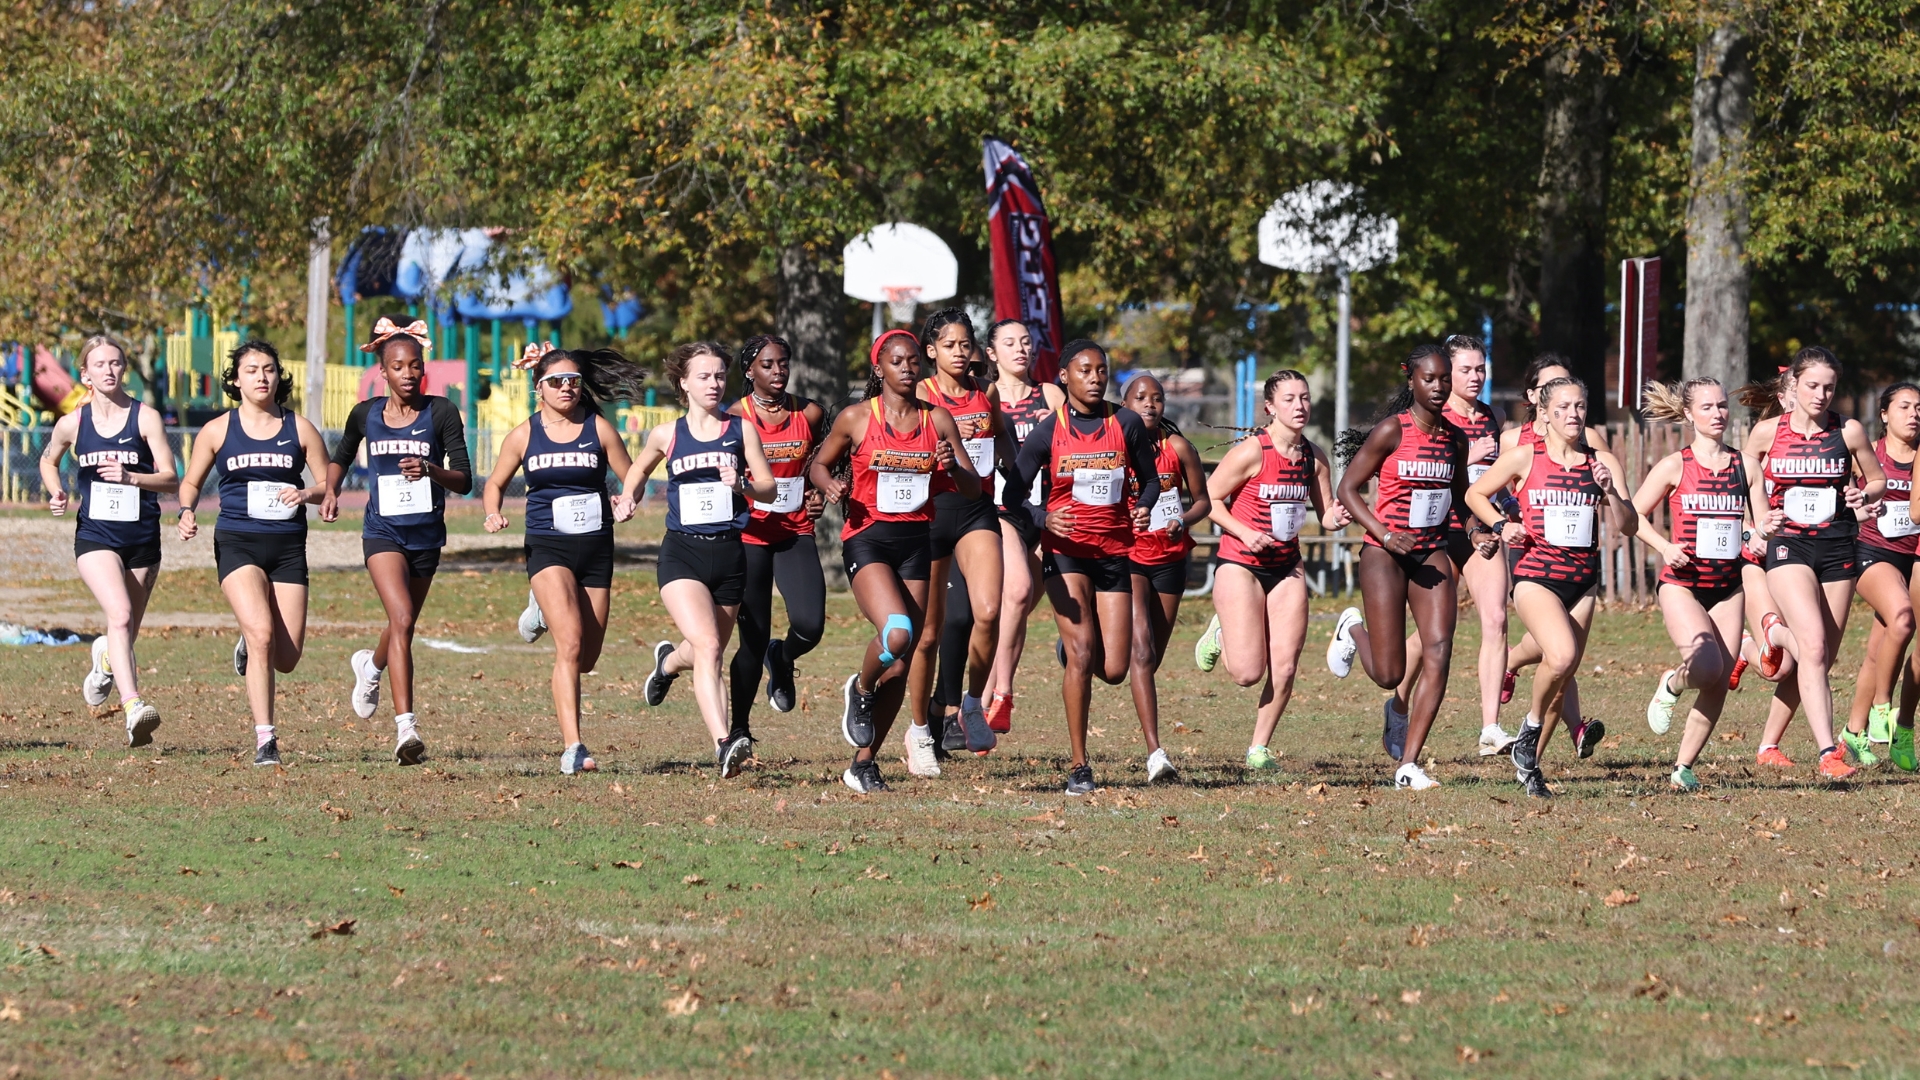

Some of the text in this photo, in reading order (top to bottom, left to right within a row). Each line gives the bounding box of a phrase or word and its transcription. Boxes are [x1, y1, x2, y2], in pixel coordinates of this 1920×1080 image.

[369, 439, 431, 457] QUEENS
[226, 452, 294, 472] QUEENS
[527, 452, 599, 472] QUEENS
[671, 451, 738, 475] QUEENS
[968, 455, 981, 466] 37
[895, 489, 912, 500] 138
[1091, 485, 1109, 495] 135
[399, 491, 412, 502] 23
[776, 494, 788, 502] 34
[109, 499, 120, 509] 21
[268, 498, 281, 508] 27
[700, 500, 713, 511] 25
[1804, 503, 1815, 513] 14
[1162, 505, 1179, 517] 136
[1428, 504, 1438, 516] 12
[573, 511, 586, 522] 22
[1894, 516, 1910, 526] 148
[1287, 520, 1295, 530] 16
[1566, 523, 1577, 534] 17
[1717, 536, 1727, 547] 18
